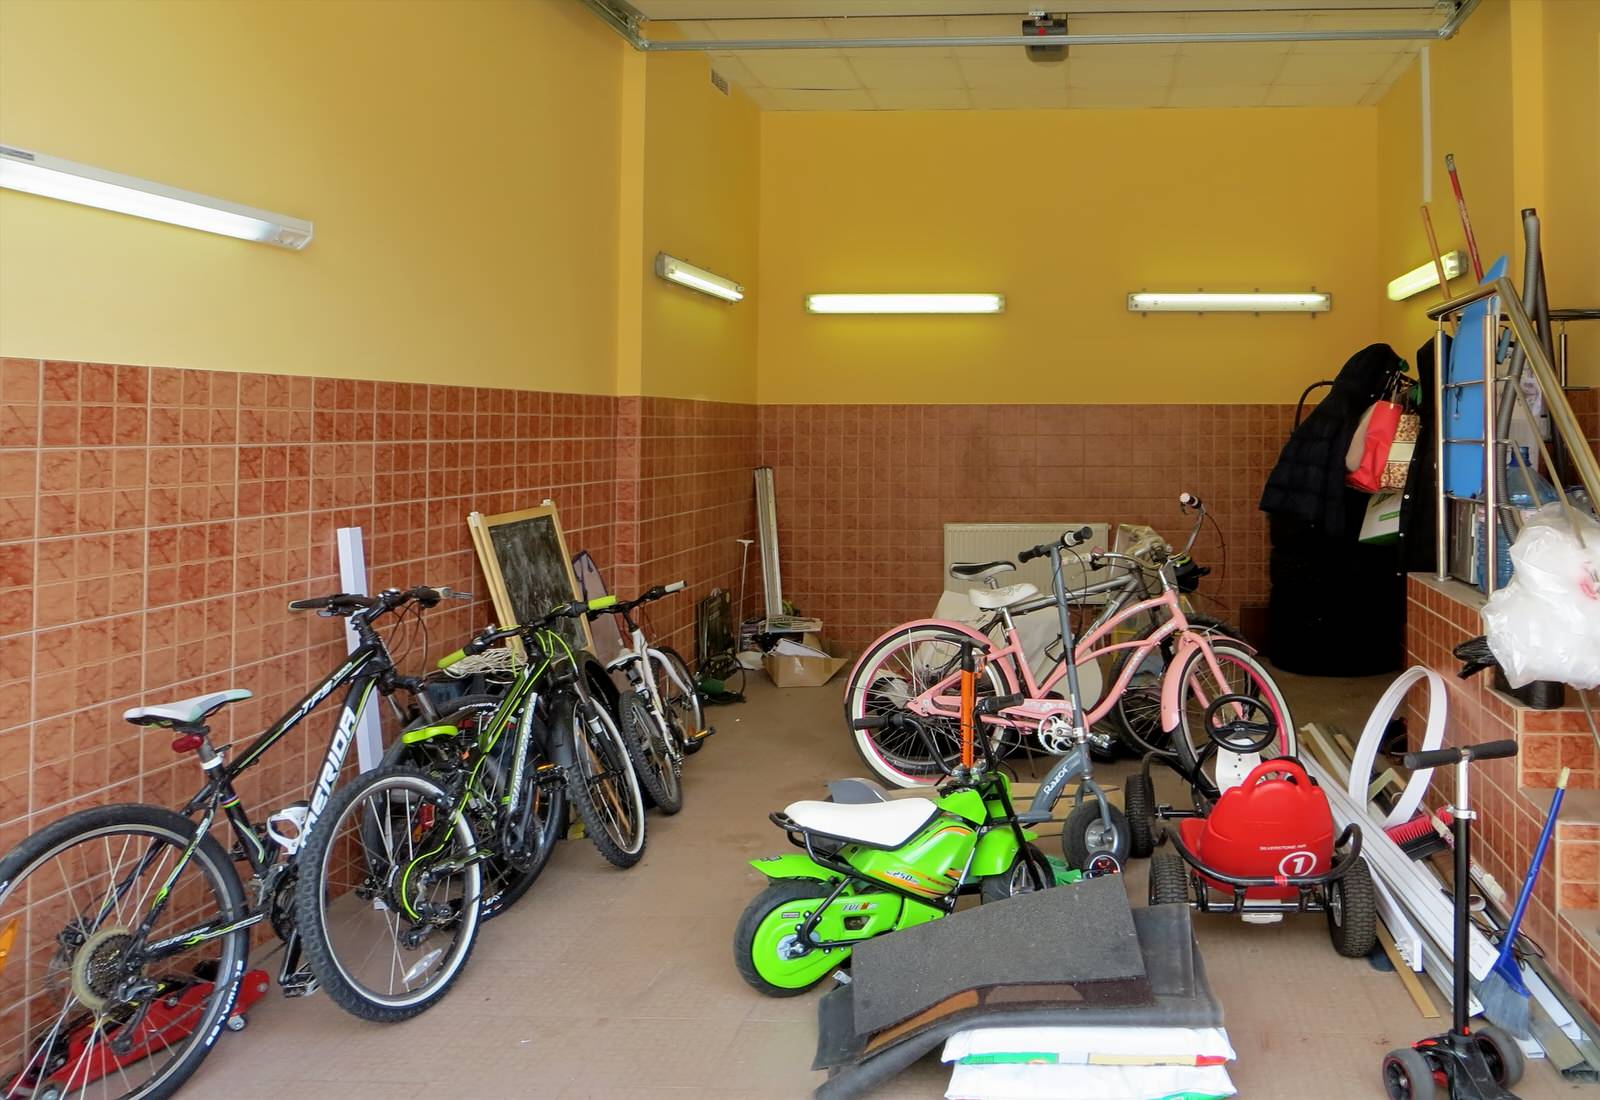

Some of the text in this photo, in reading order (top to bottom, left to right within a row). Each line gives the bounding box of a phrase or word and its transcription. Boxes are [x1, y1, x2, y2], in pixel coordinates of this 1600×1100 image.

[300, 705, 356, 848] MERIDA
[1043, 764, 1069, 795] Razor
[1293, 857, 1305, 874] 1
